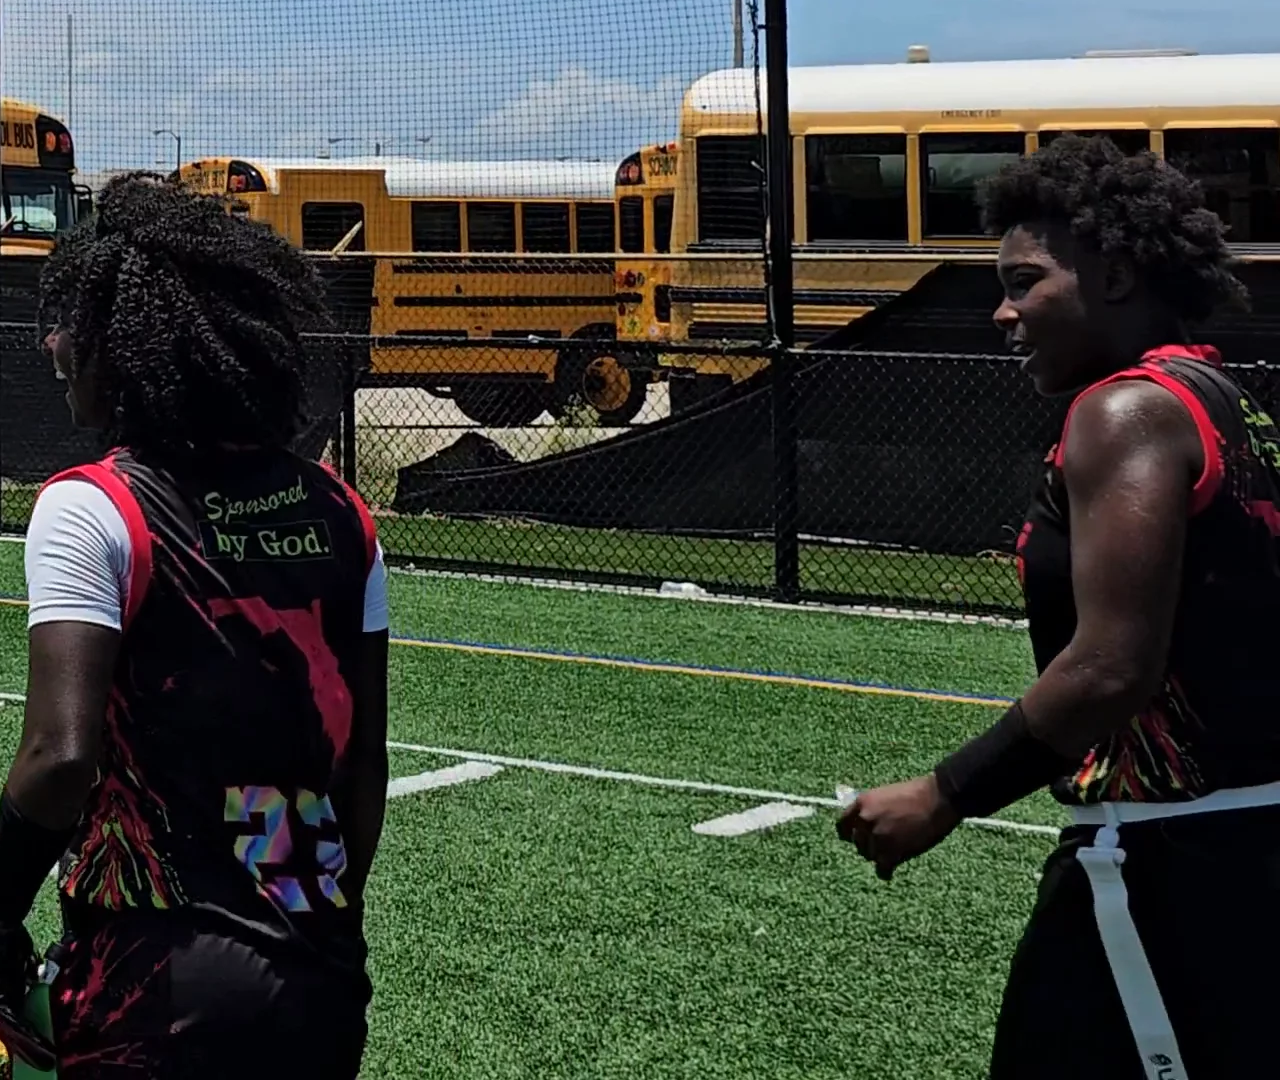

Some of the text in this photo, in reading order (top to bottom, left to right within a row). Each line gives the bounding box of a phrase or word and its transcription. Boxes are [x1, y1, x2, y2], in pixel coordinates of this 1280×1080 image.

[14, 122, 35, 150] BUS
[204, 474, 309, 524] Sponsored
[211, 525, 330, 562] by God.
